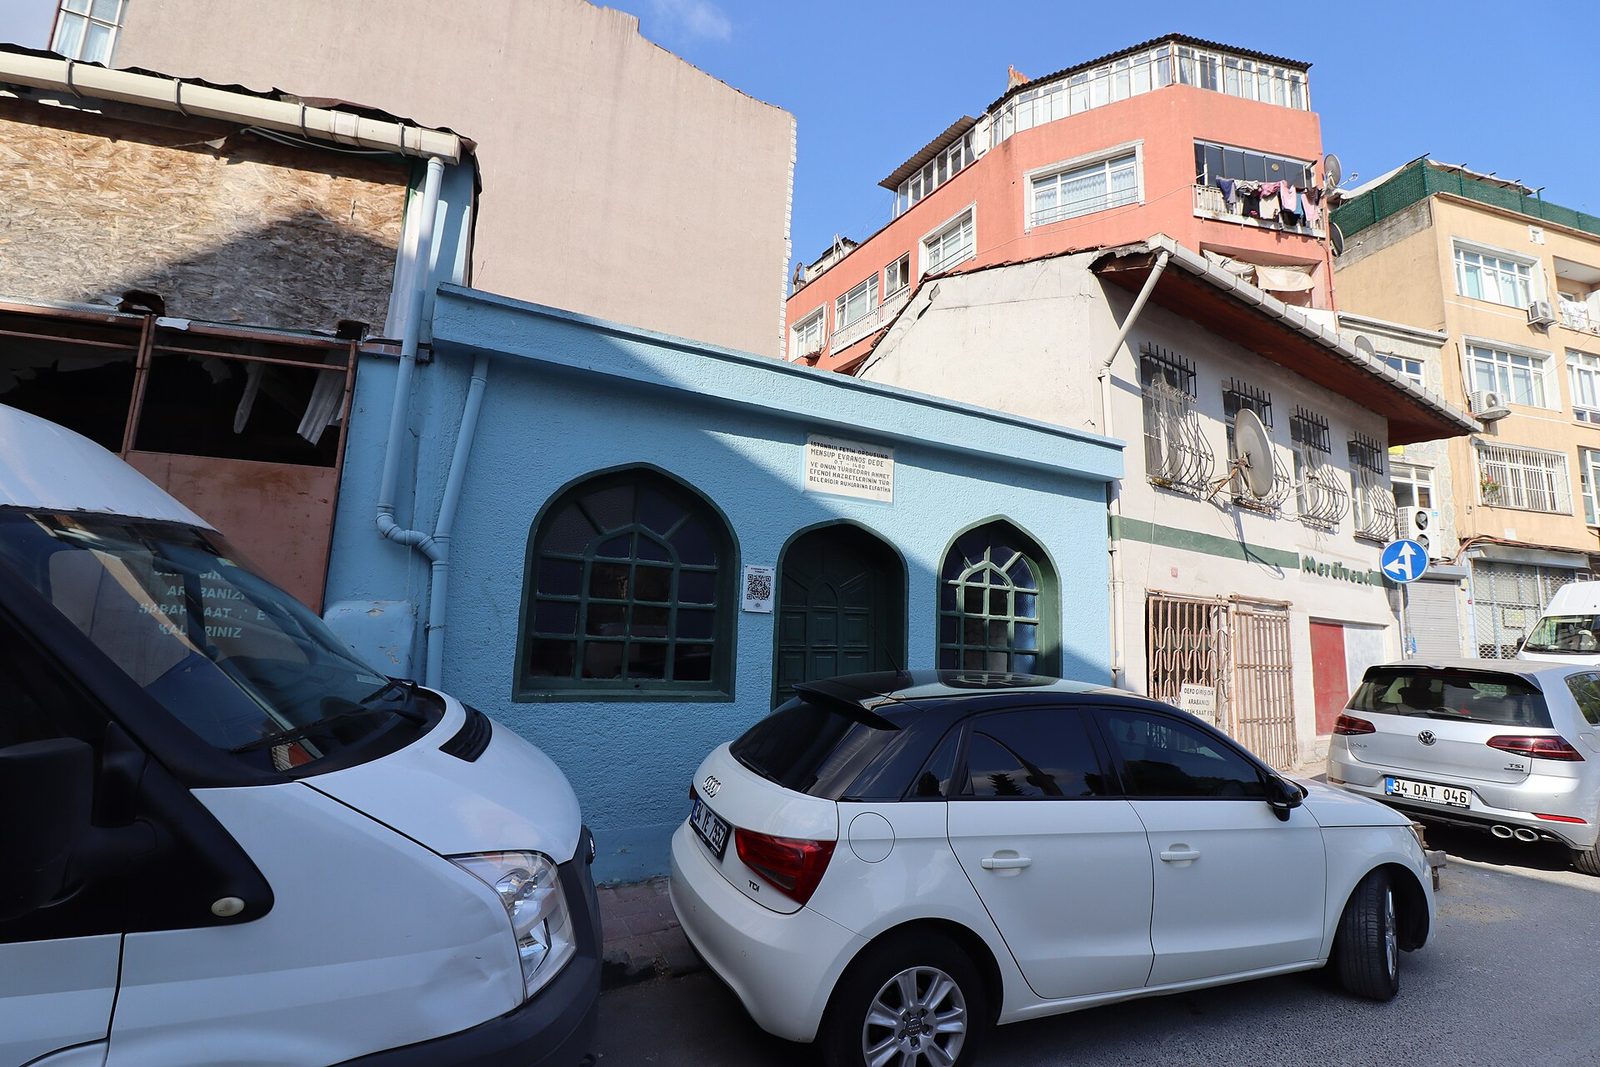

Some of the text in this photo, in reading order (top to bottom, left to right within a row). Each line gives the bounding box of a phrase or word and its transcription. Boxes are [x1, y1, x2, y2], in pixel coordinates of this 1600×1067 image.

[810, 448, 885, 468] MENSUP EVRANOS DEDE
[820, 463, 836, 471] ONUN
[1394, 780, 1407, 794] 34
[1413, 783, 1436, 798] DAT
[1443, 789, 1467, 804] 046
[748, 879, 761, 892] TDI
